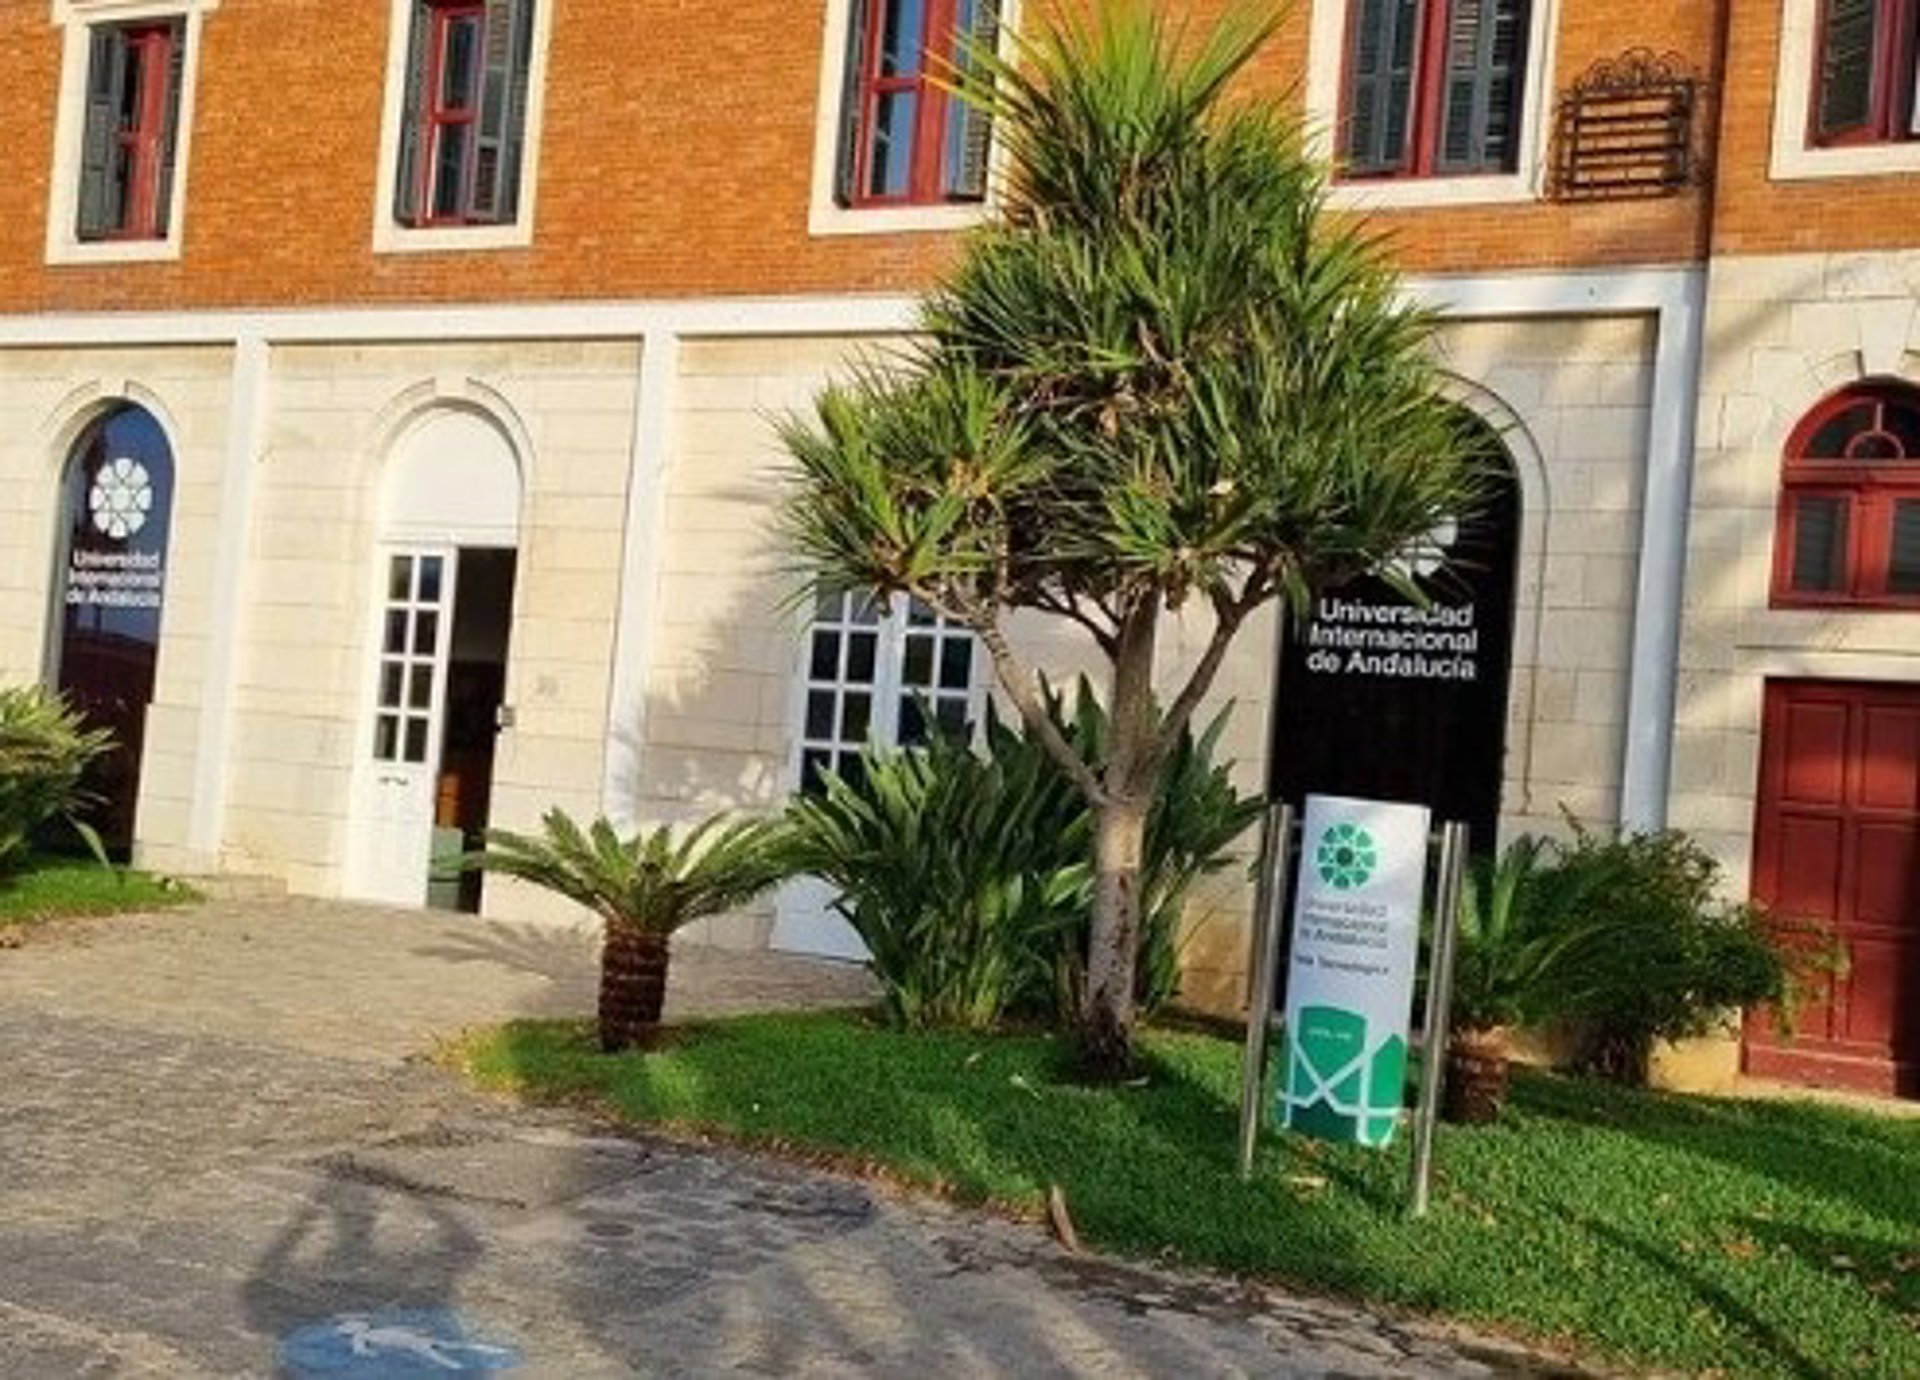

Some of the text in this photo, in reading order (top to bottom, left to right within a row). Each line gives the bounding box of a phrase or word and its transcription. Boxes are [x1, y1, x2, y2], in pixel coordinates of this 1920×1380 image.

[1309, 622, 1479, 652] Internacional
[1306, 649, 1475, 679] de Andalucía
